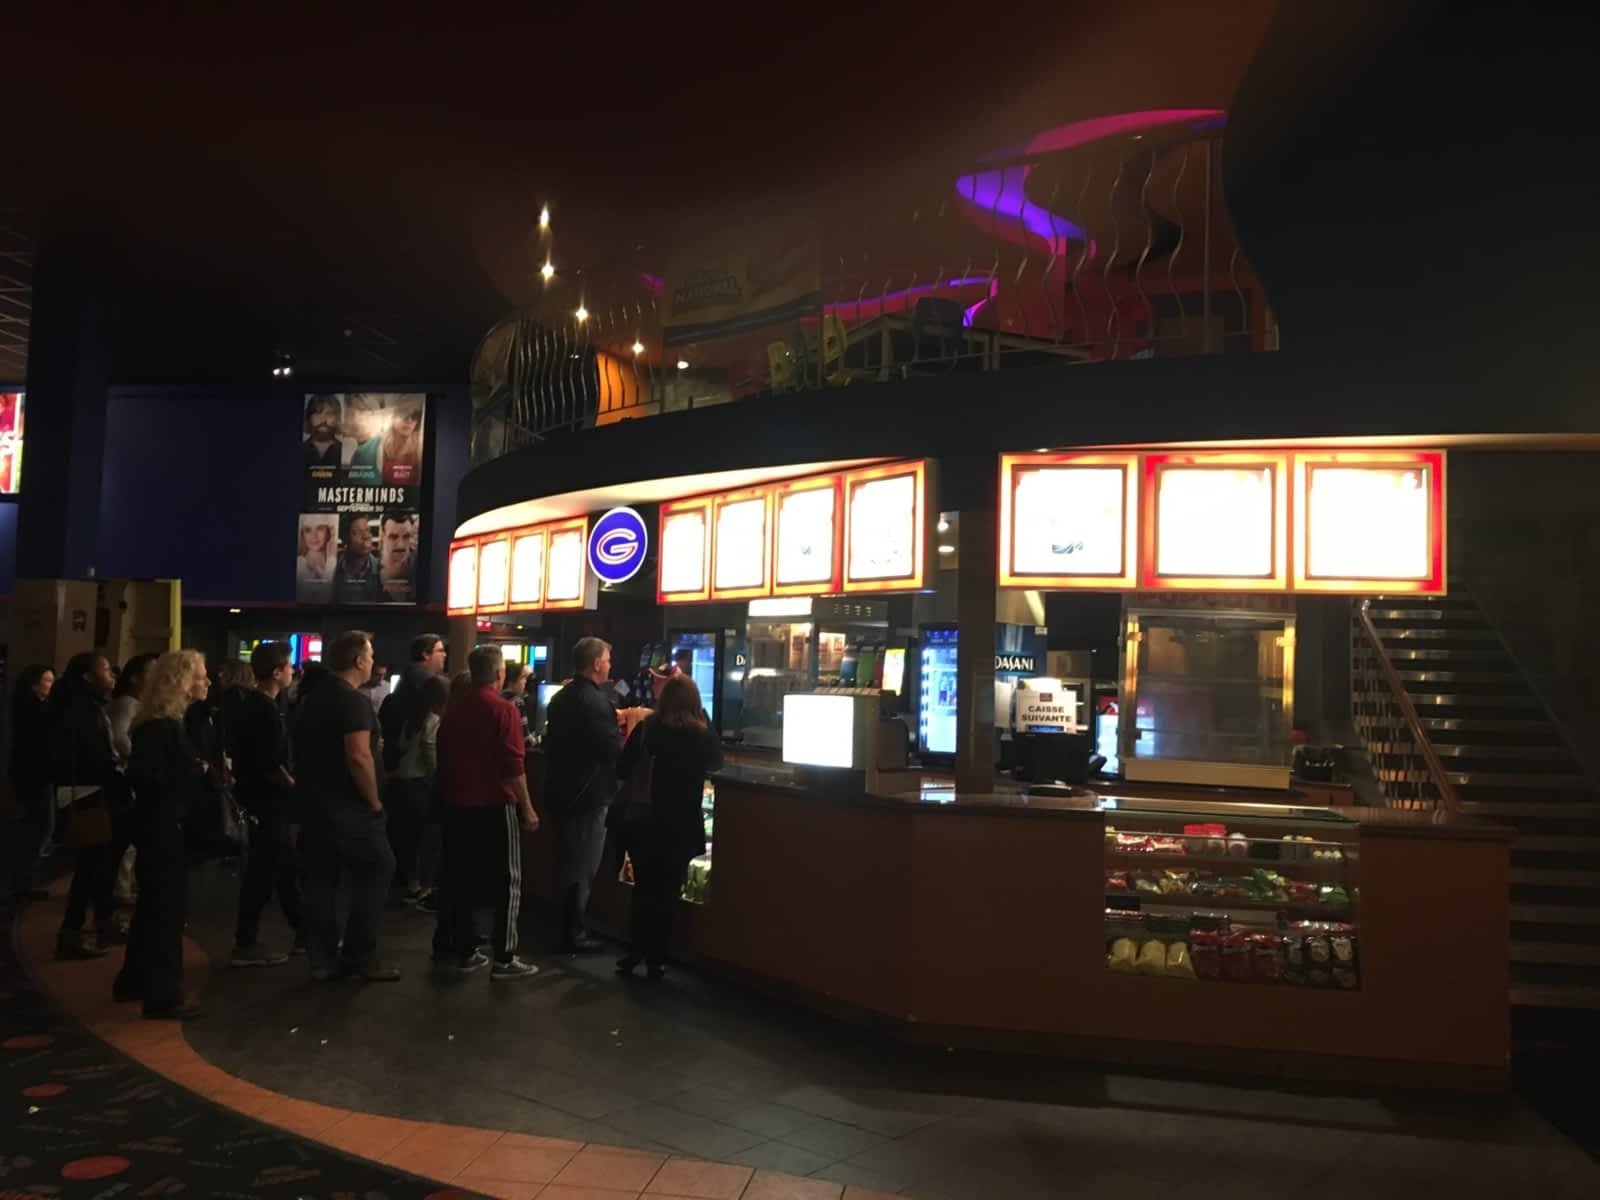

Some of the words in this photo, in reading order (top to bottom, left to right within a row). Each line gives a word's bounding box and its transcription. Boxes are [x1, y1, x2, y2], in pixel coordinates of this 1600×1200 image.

[318, 487, 404, 503] MASTERMINDS
[596, 528, 638, 564] G
[994, 655, 1034, 671] DASANI
[1028, 705, 1065, 713] CAISSE
[1021, 714, 1072, 722] SUIVANTE
